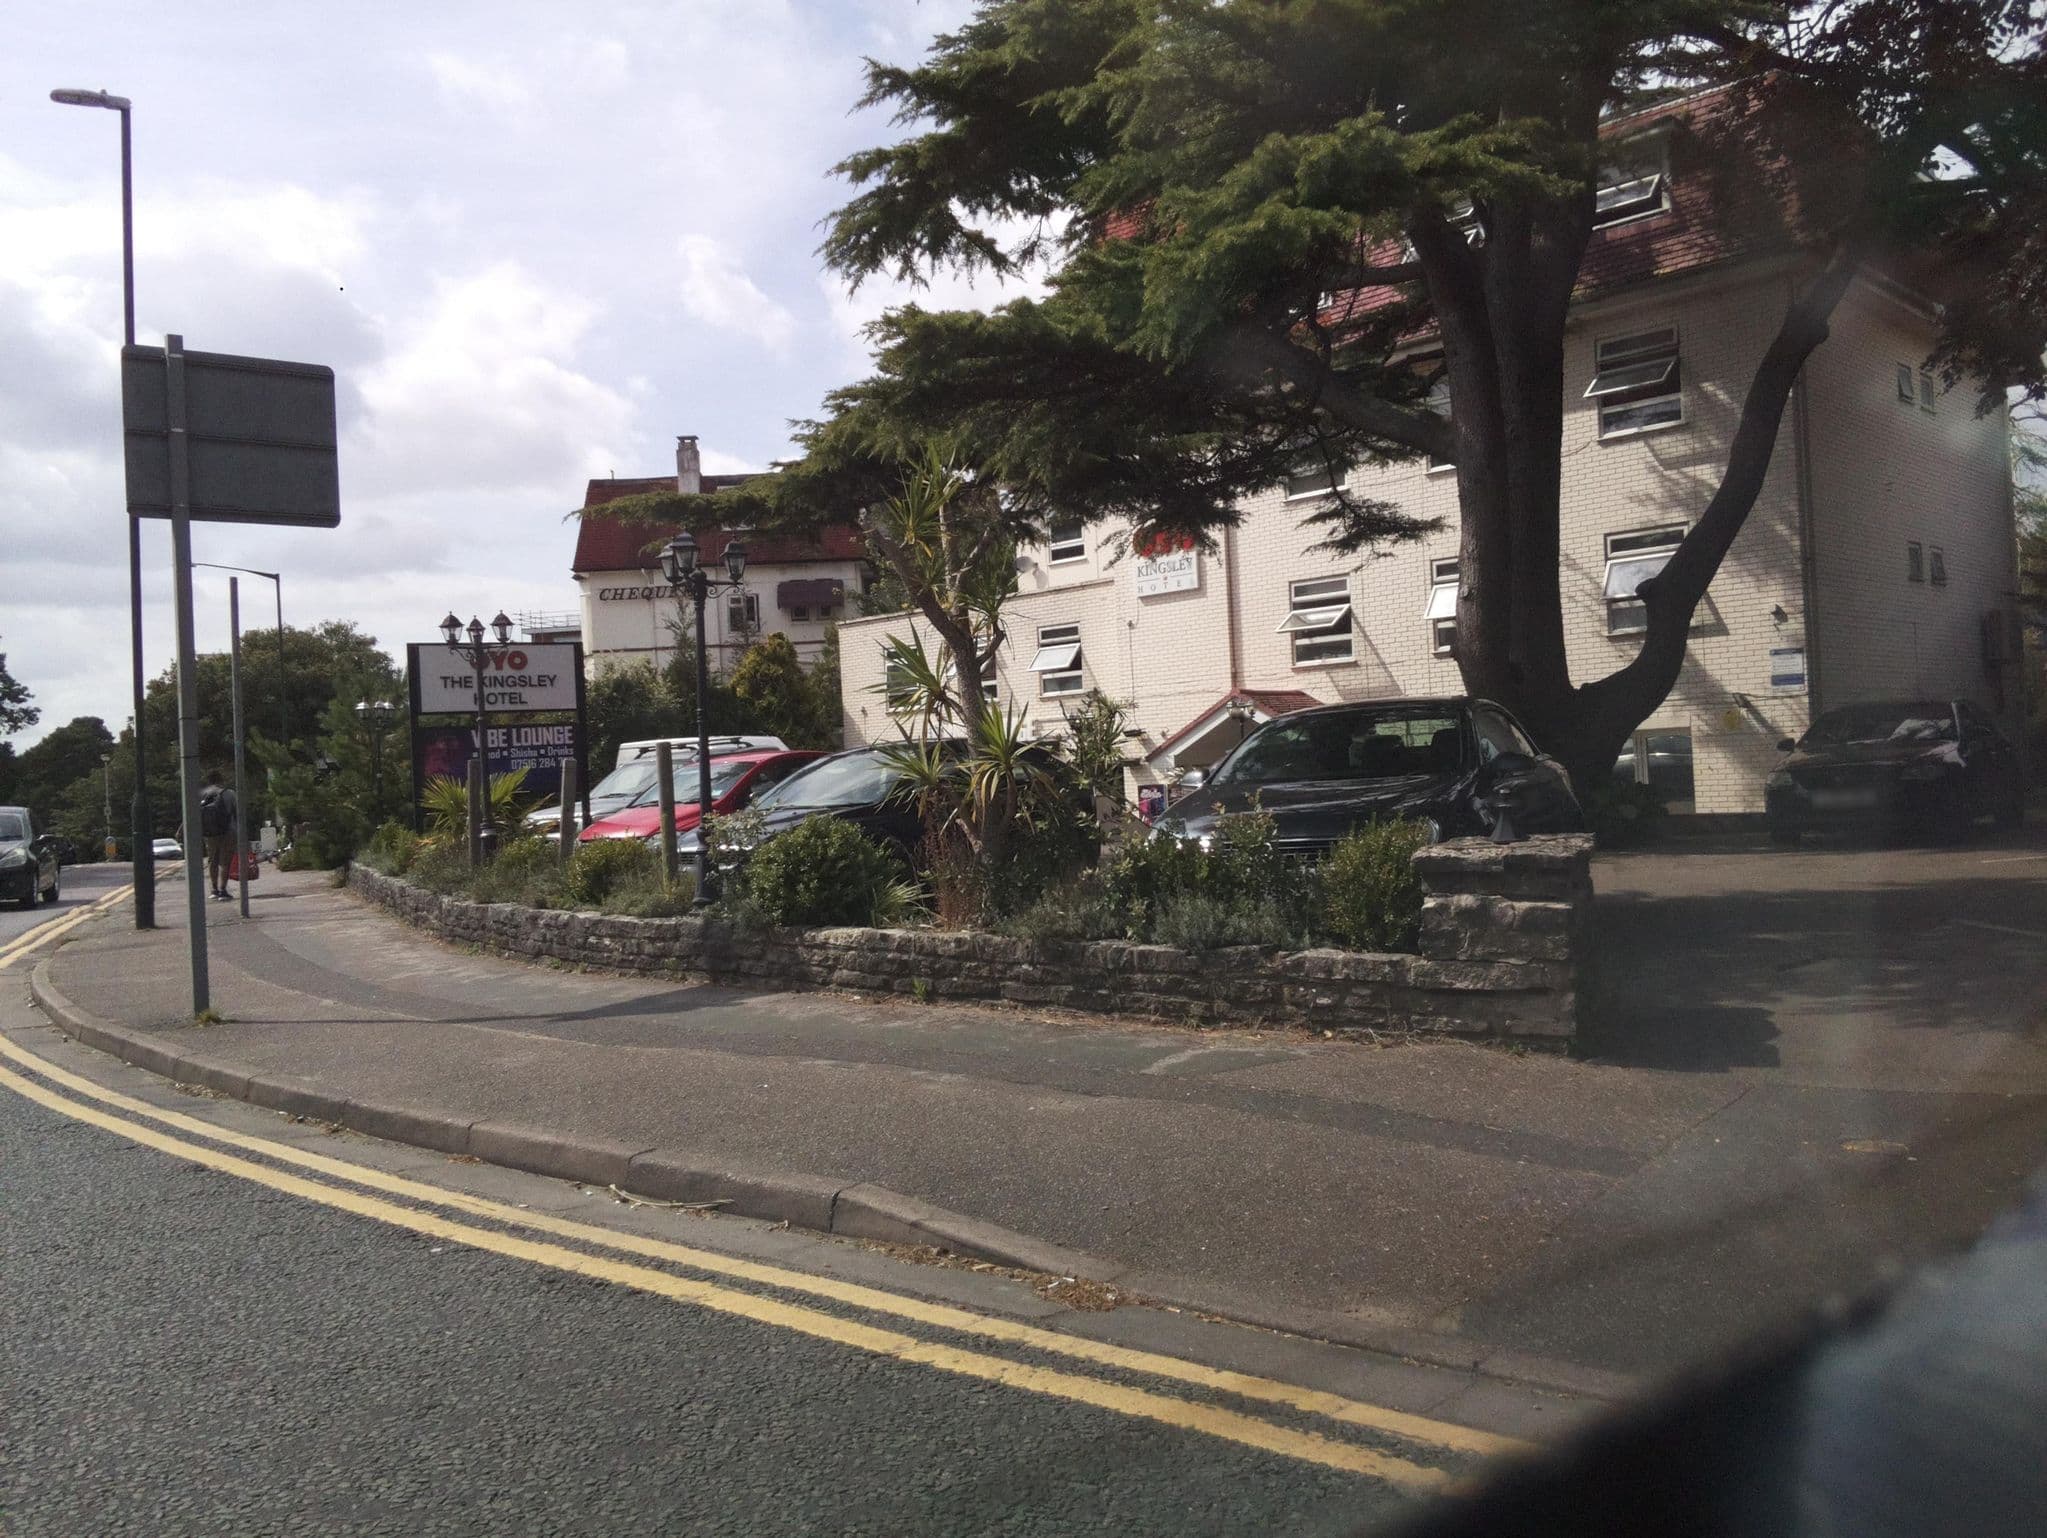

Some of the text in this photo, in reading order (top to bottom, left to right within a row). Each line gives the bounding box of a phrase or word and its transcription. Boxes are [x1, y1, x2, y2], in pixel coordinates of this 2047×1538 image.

[1137, 579, 1194, 593] HOTE
[440, 675, 473, 689] THE
[471, 726, 574, 748] VBE LOUNGE
